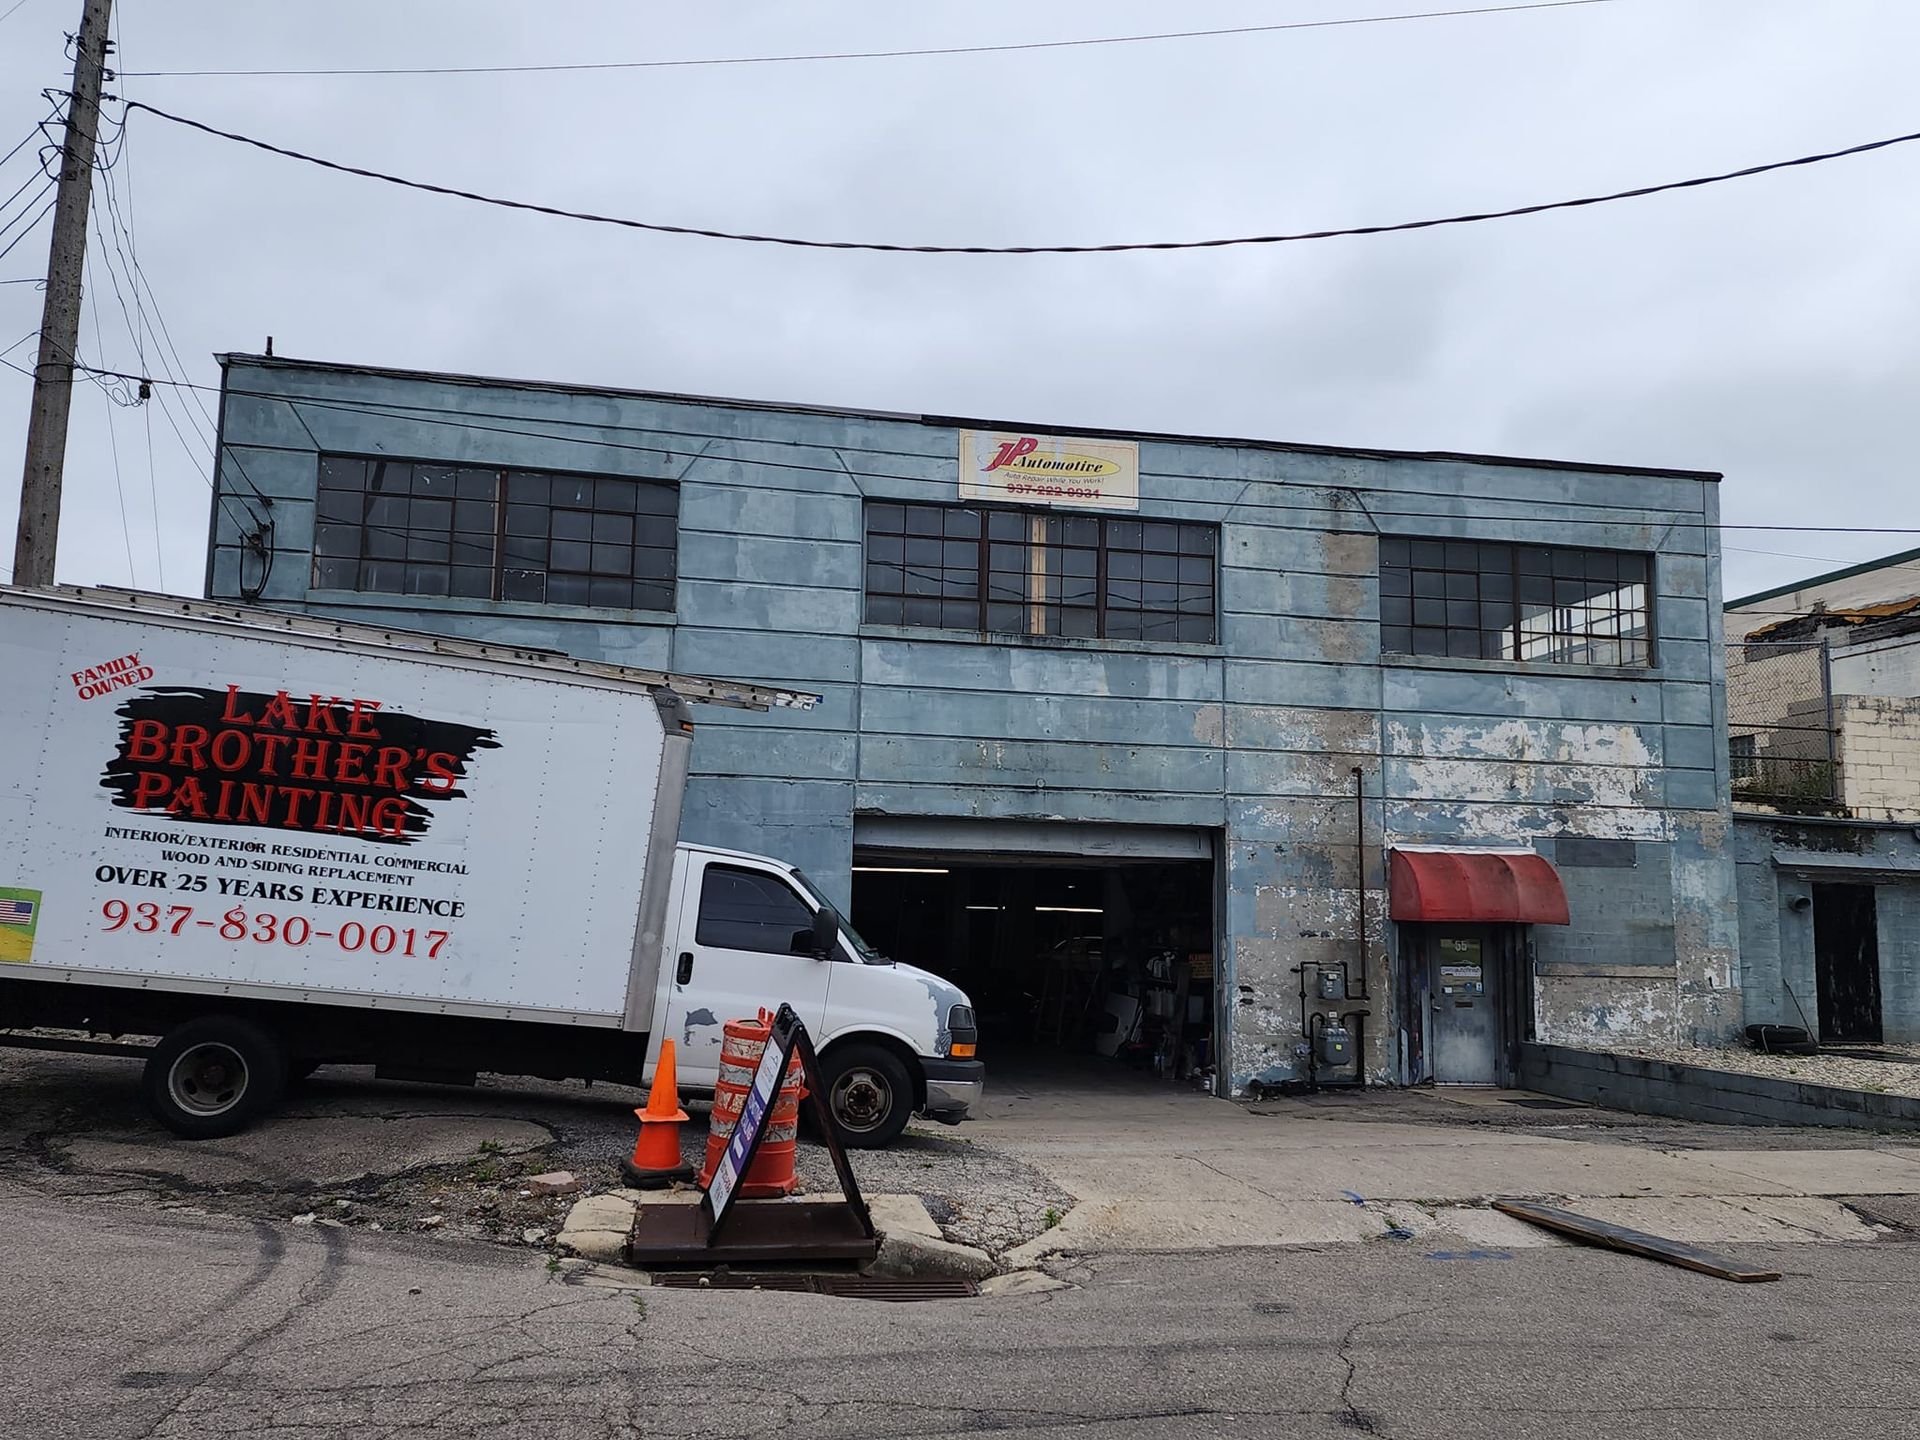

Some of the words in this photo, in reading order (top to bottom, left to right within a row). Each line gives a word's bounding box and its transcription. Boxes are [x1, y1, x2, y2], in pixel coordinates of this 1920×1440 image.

[980, 437, 1039, 472] JP
[1013, 456, 1103, 473] Automotive
[1022, 474, 1045, 483] Repair
[1046, 476, 1066, 484] While
[70, 652, 140, 688] FAMILY
[78, 666, 154, 701] OWNED
[220, 684, 382, 740] LAKE
[126, 719, 459, 793] BROTHER'S
[132, 771, 410, 837] PAINTING
[104, 827, 267, 854] INTERIOR/EXTERIOR
[271, 844, 370, 865] RESIDENTIAL
[374, 855, 470, 876] COMMERCIAL
[161, 850, 211, 866] WOOD
[214, 855, 248, 869] AND
[251, 860, 304, 875] SIDING
[308, 865, 415, 887] REPLACEMENT
[95, 864, 168, 889] OVER
[177, 873, 208, 893] 25
[218, 877, 304, 902] YEARS
[311, 887, 466, 919] EXPERIENCE
[100, 898, 451, 960] 937-830-0017
